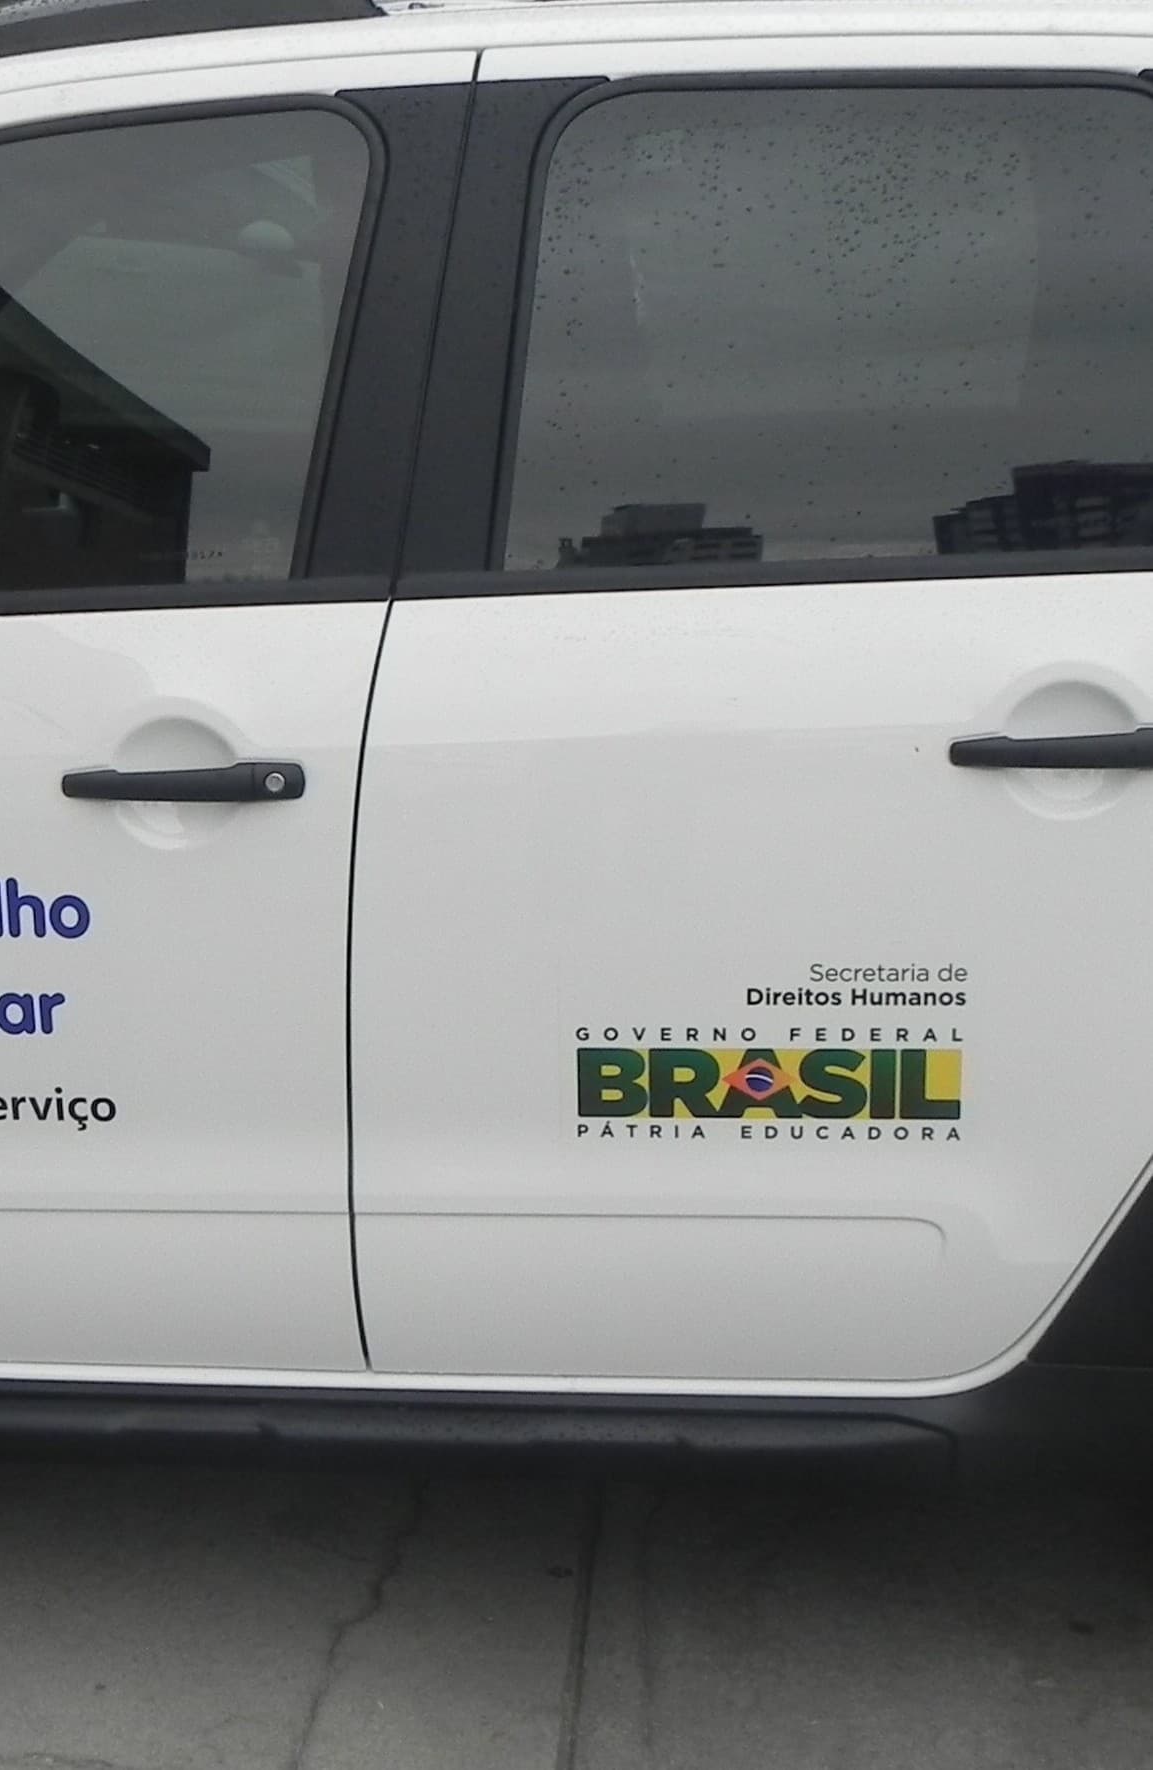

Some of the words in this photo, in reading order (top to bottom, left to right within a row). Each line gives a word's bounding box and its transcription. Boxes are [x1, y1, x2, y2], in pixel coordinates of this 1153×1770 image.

[809, 963, 930, 983] Secretaria
[937, 963, 968, 983] de
[746, 987, 842, 1006] Direitos
[851, 988, 967, 1007] Humanos
[575, 1027, 757, 1042] GOVERNO
[789, 1027, 963, 1042] FEDERAL
[577, 1048, 962, 1119] BRASIL
[577, 1120, 705, 1139] PÁTRIA
[740, 1125, 961, 1142] EDUCADORA
